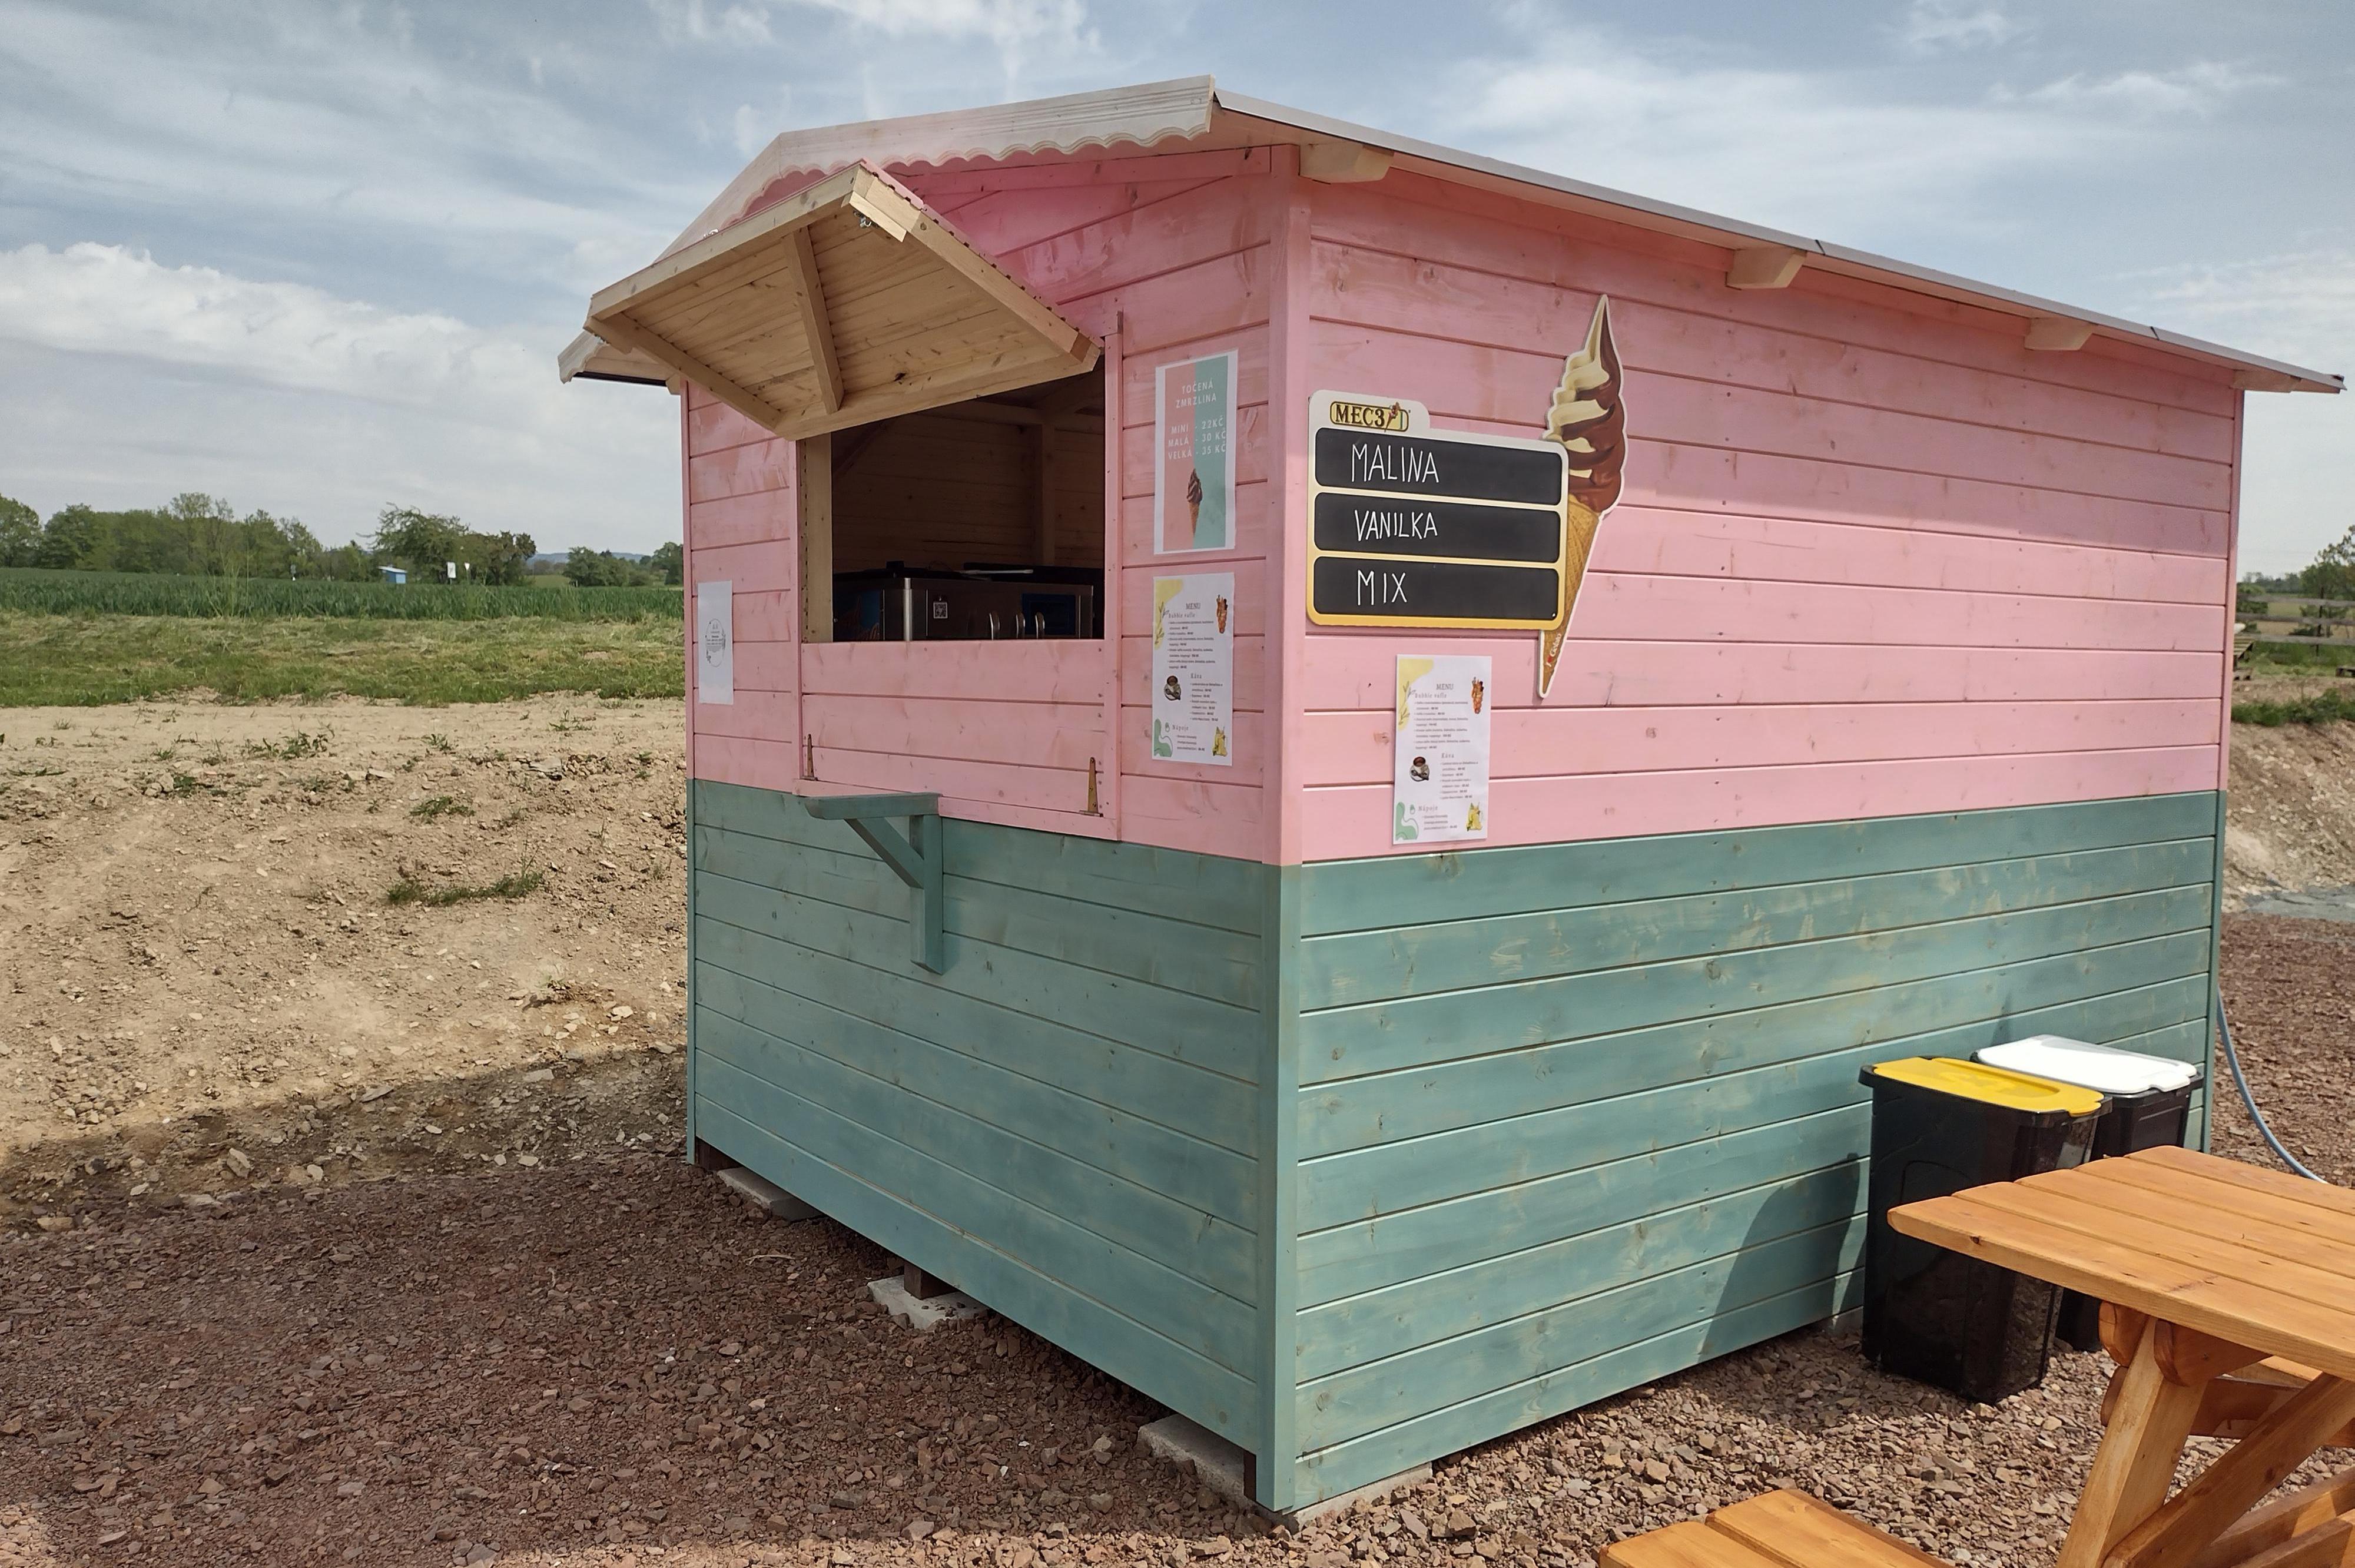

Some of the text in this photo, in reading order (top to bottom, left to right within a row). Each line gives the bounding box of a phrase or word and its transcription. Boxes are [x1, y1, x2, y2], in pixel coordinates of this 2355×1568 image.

[1182, 377, 1213, 395] TOČENÁ
[1176, 392, 1216, 409] ZMRZLINA
[1335, 404, 1385, 427] MEC3
[1172, 423, 1188, 435] MINI
[1168, 433, 1189, 447] MALÁ
[1202, 433, 1212, 442] 30
[1168, 446, 1192, 460] VELKÁ
[1202, 446, 1211, 456] 35
[1351, 443, 1439, 483] MALINA
[1354, 509, 1438, 541] VANILKA
[1356, 569, 1407, 606] MIX
